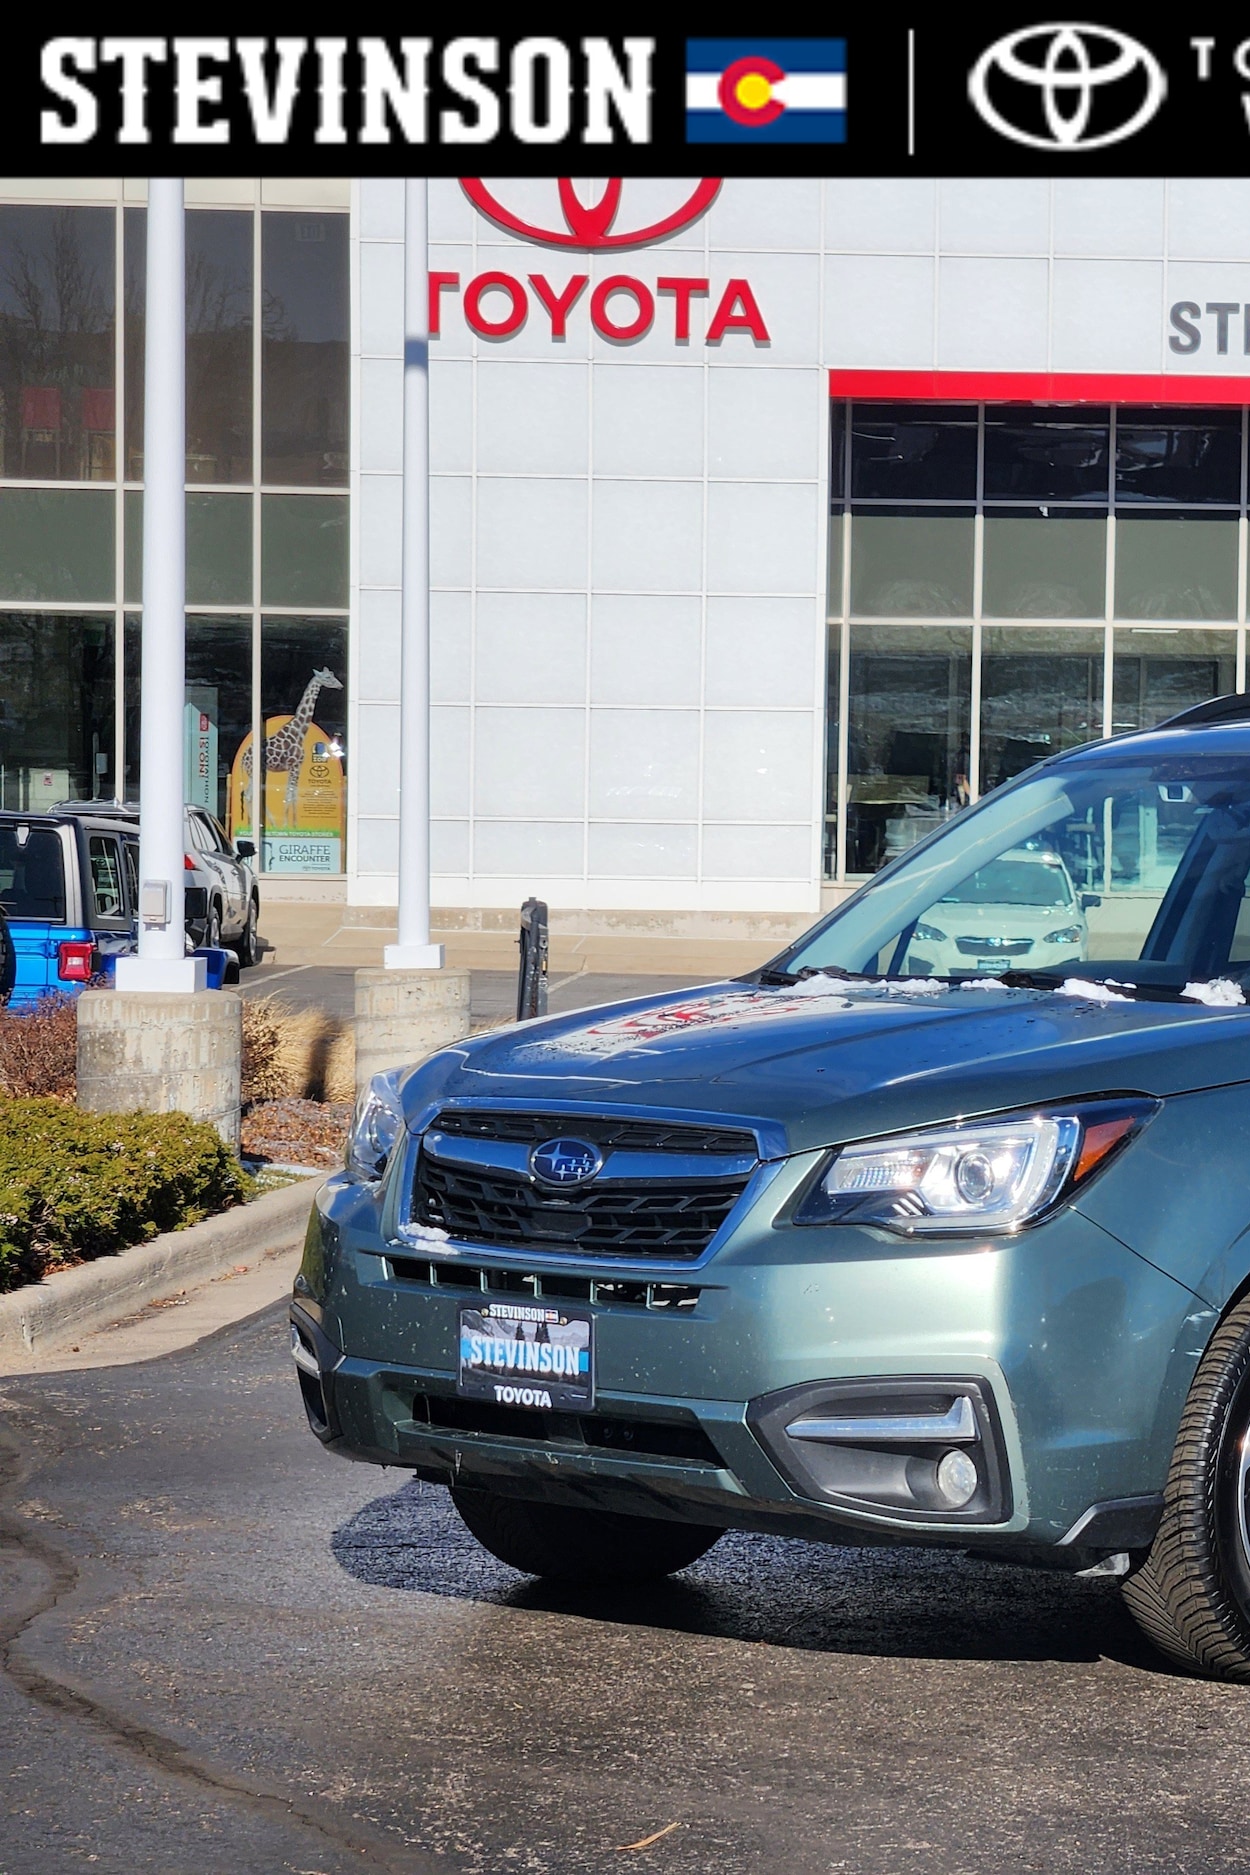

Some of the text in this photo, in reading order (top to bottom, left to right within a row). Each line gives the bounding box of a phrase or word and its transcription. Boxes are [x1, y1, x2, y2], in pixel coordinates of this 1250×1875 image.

[427, 271, 771, 343] TOYOTA
[279, 844, 331, 855] GIRAFFE
[489, 1303, 545, 1322] STEVINSON
[470, 1335, 581, 1376] STEVINSON
[494, 1385, 552, 1409] TOYOTA
